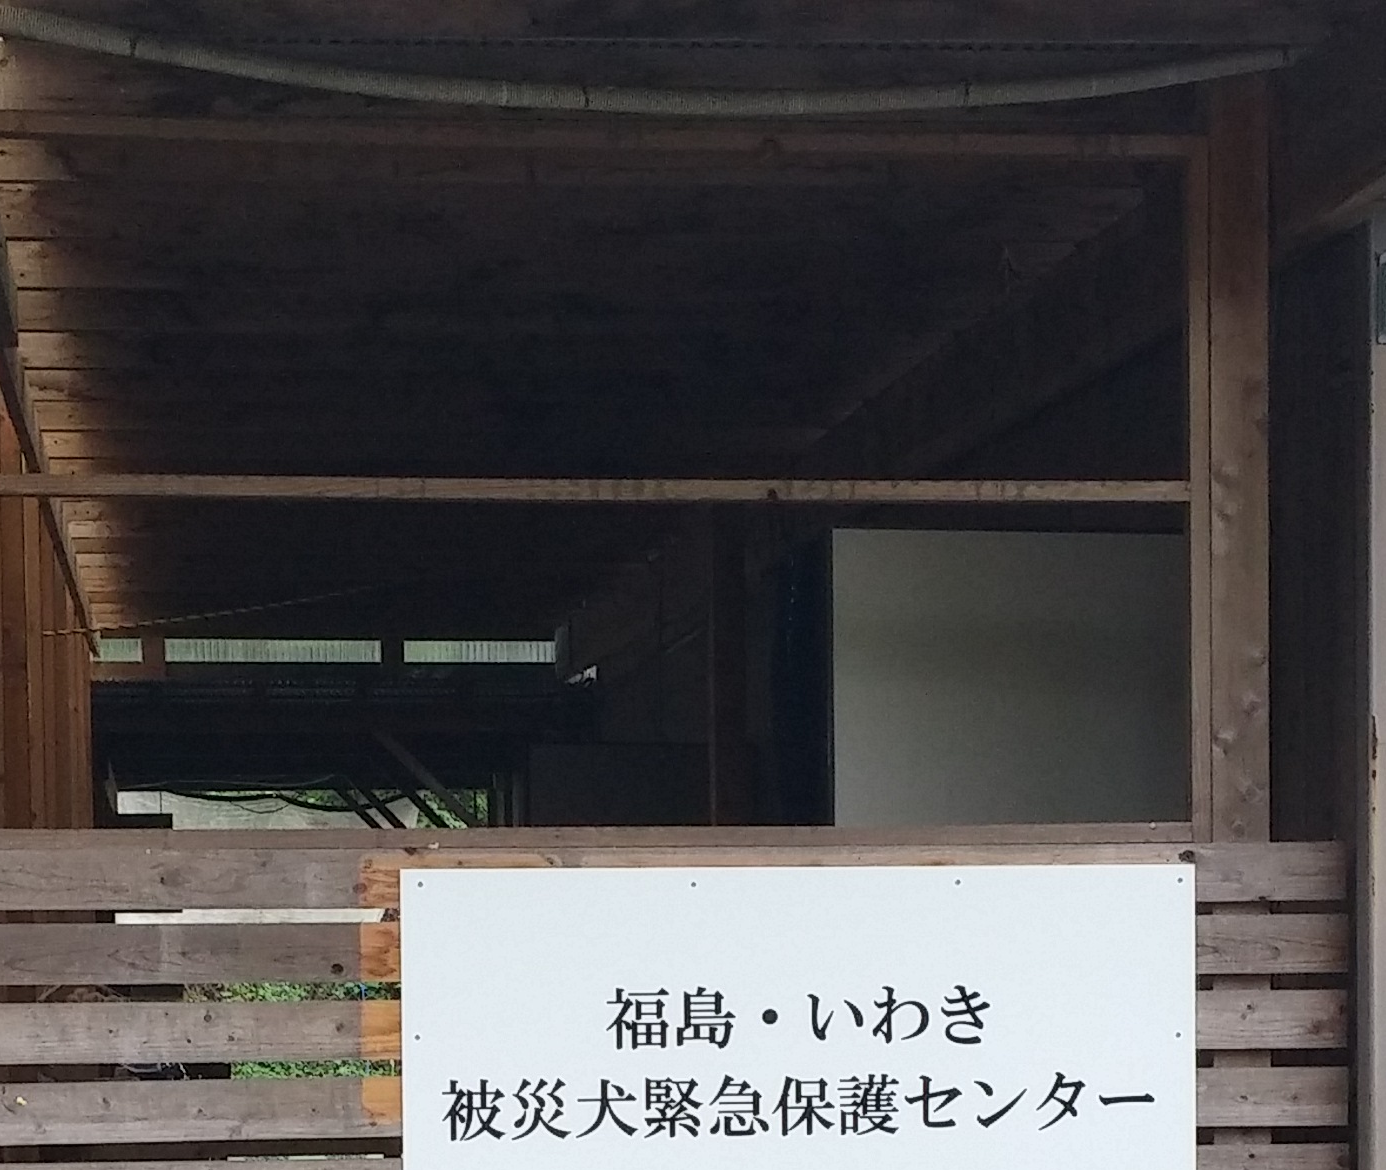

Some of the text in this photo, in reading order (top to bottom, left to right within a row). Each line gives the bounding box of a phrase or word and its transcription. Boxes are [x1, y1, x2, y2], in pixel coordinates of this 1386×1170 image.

[605, 984, 992, 1051] 福島・いわき
[441, 1071, 1157, 1142] 被災犬緊急保護センター
